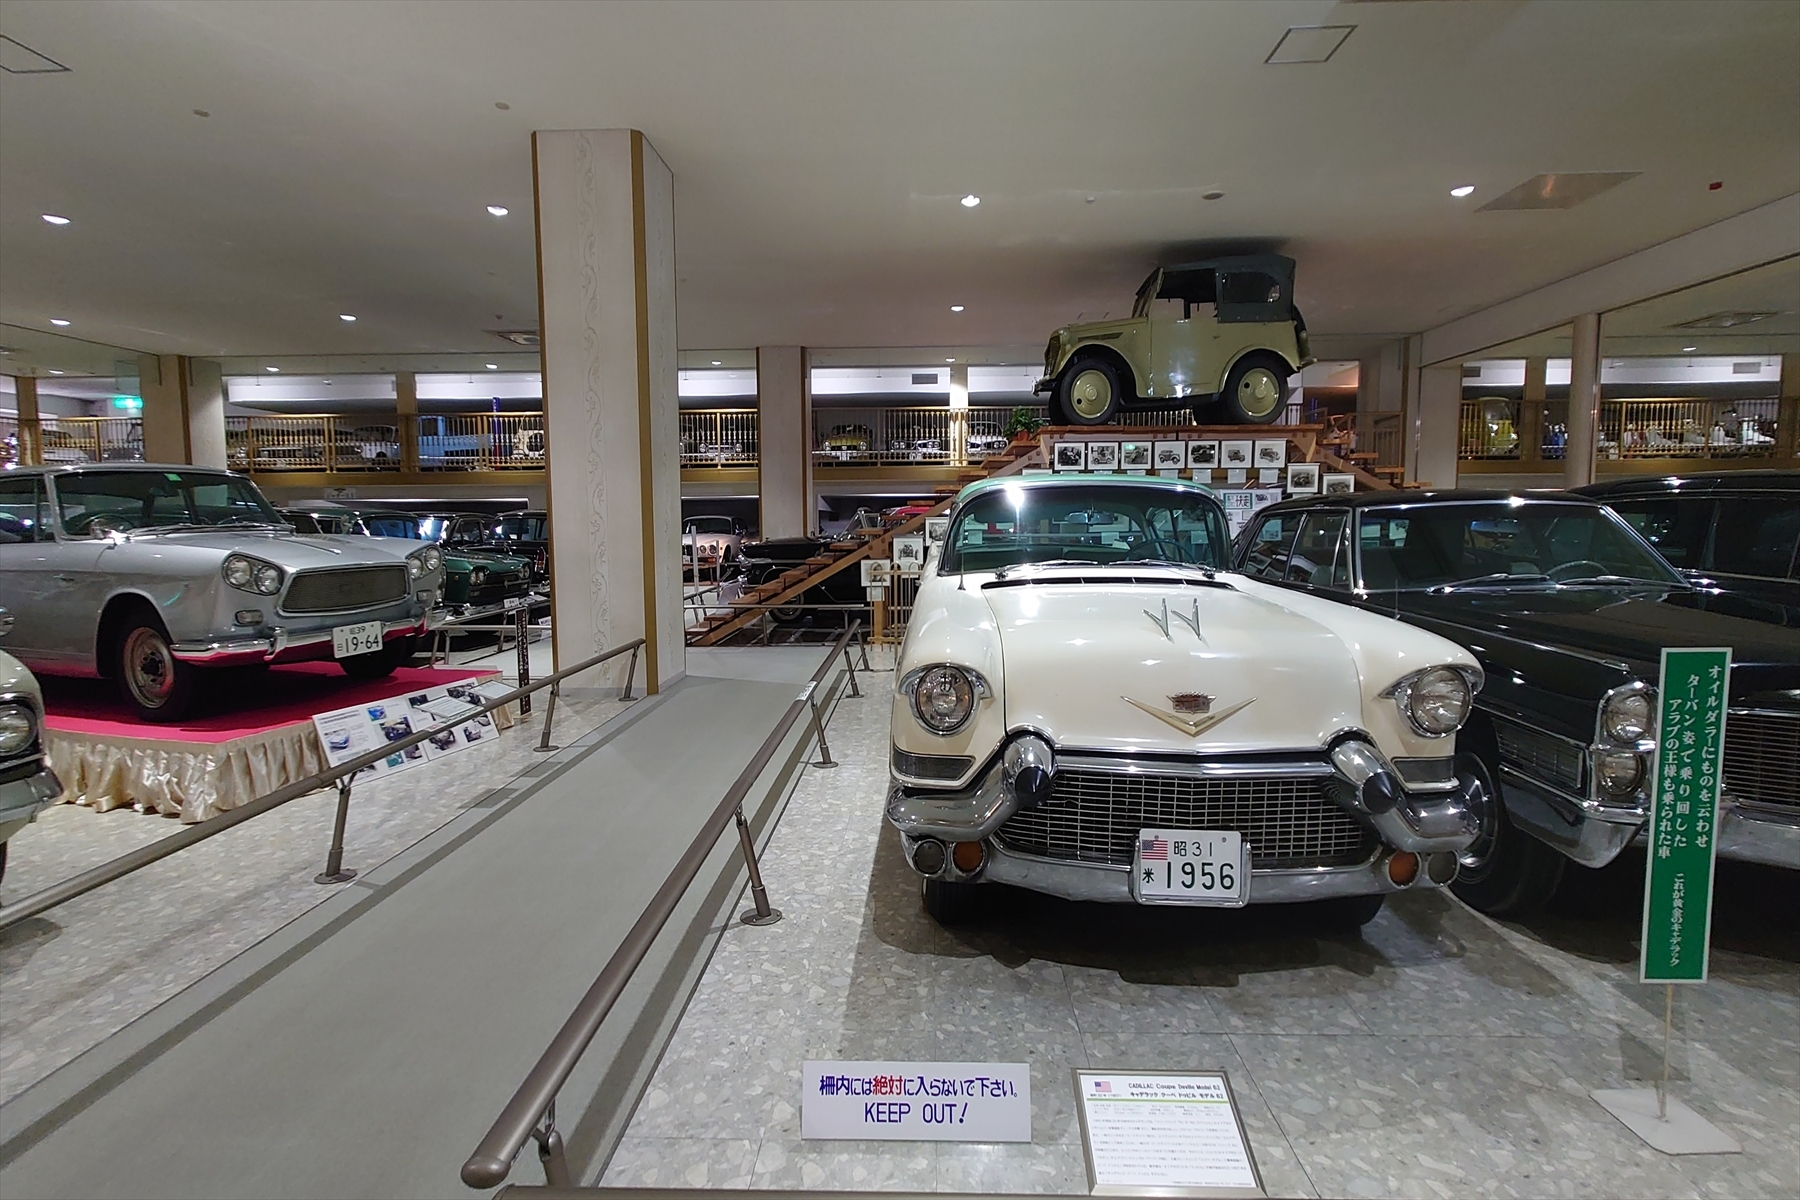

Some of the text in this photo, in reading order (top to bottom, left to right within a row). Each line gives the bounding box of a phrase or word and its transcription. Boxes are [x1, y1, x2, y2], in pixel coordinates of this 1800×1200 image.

[345, 633, 379, 653] 19-64
[1166, 861, 1235, 890] 1956
[819, 1075, 1018, 1098] 柵内には絶対に入らないで下さい。
[1156, 1083, 1176, 1091] Coupe
[864, 1102, 969, 1124] KEEP OUT!
